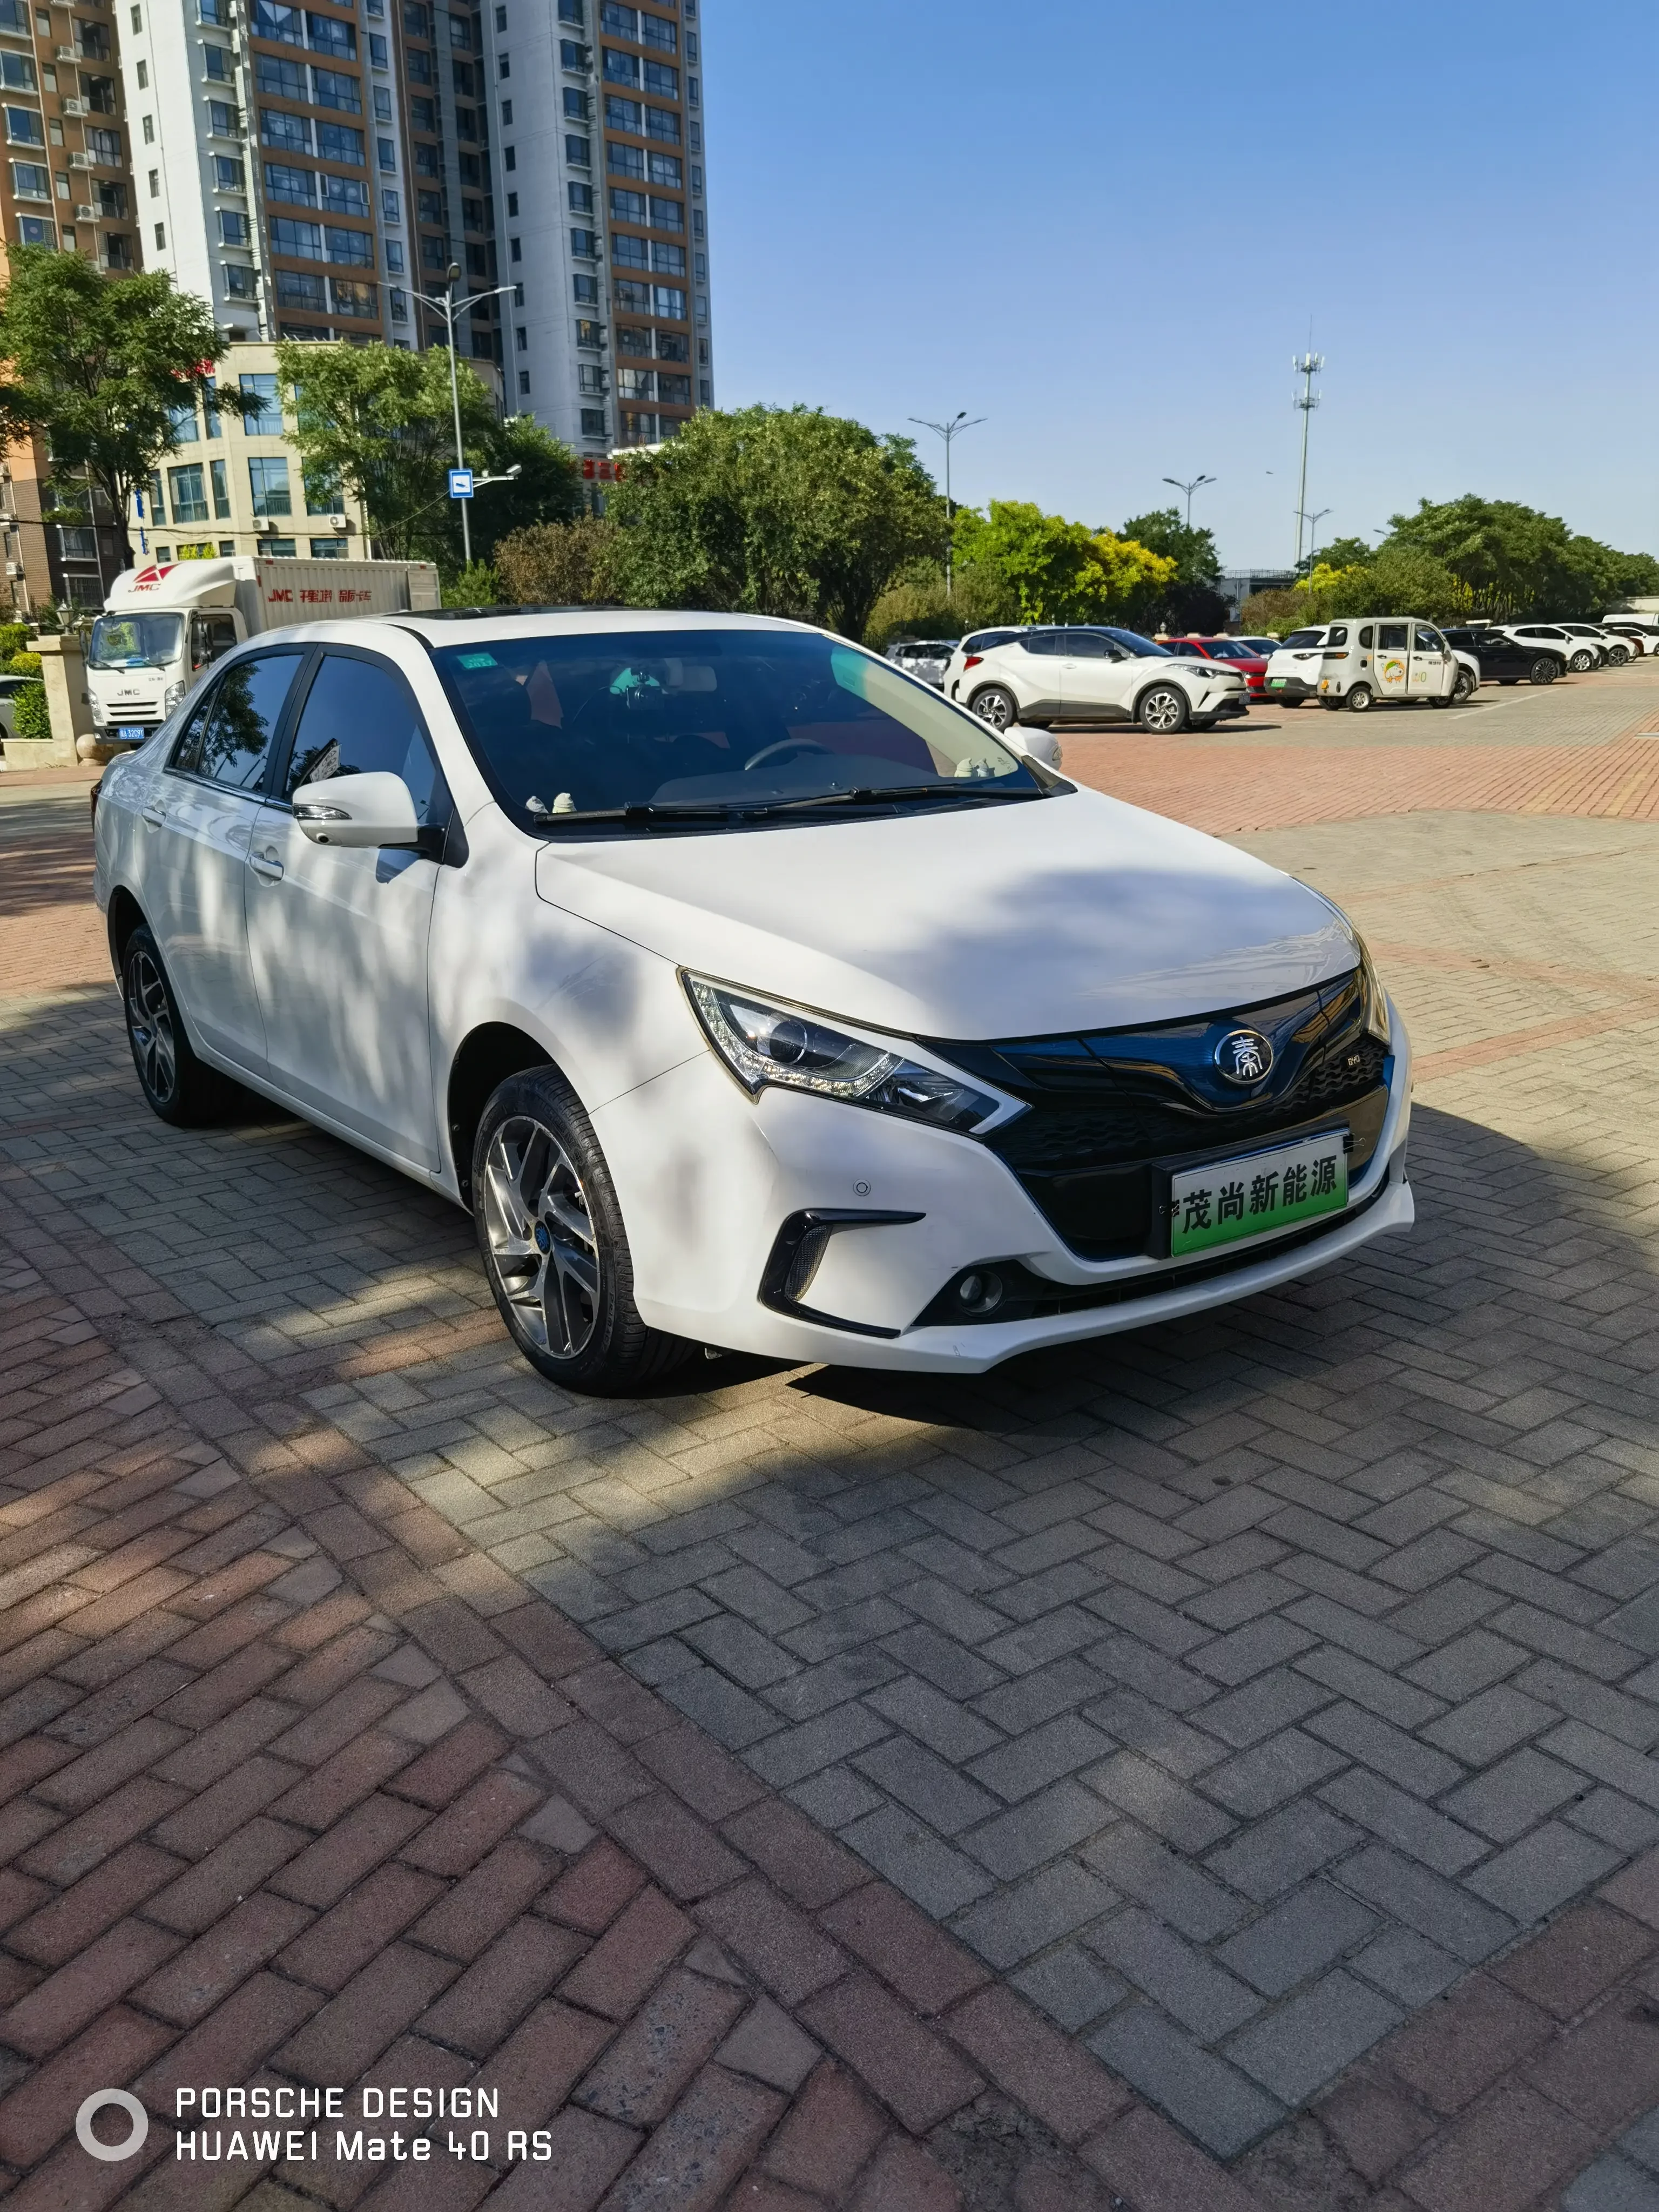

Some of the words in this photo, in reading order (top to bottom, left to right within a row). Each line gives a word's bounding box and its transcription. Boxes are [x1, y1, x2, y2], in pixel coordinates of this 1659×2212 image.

[128, 583, 161, 592] JMC
[268, 589, 293, 602] JMC
[1231, 1036, 1263, 1076] 秦
[1347, 1054, 1360, 1065] BYD
[1182, 1155, 1337, 1234] 茂尚新能源
